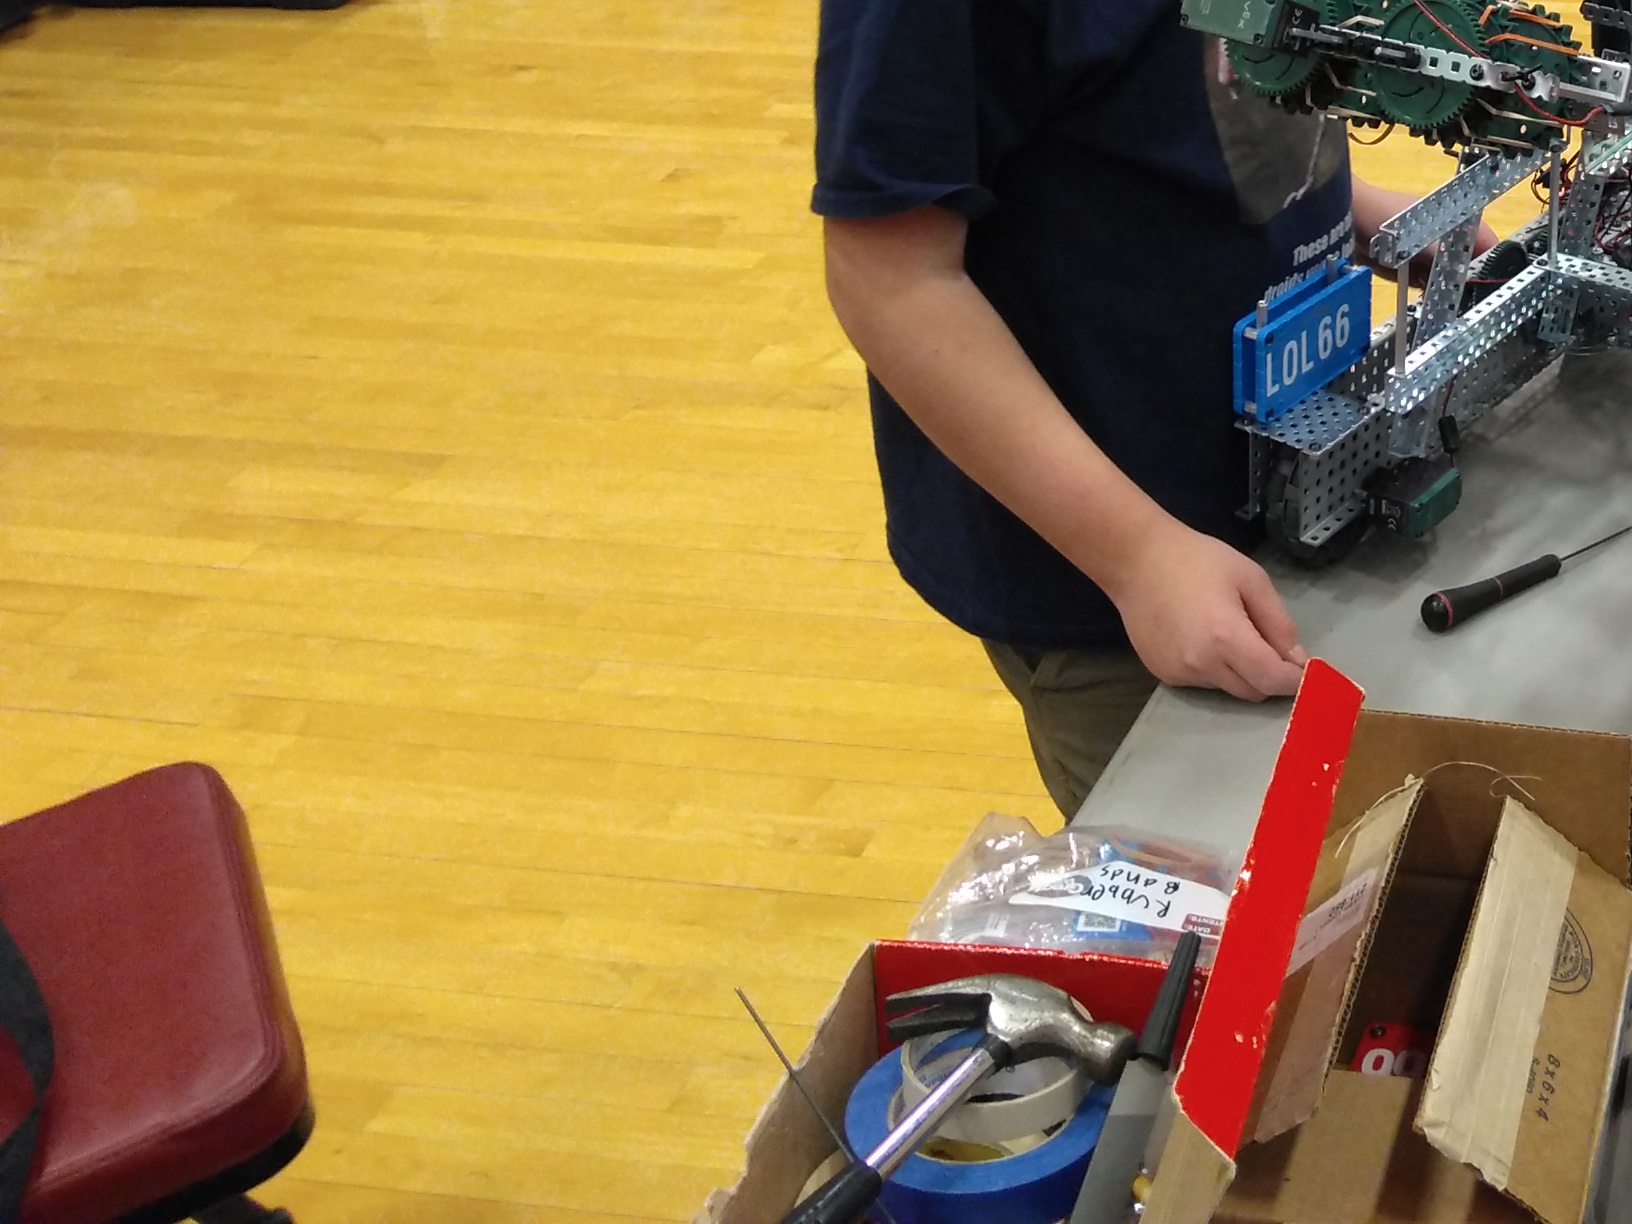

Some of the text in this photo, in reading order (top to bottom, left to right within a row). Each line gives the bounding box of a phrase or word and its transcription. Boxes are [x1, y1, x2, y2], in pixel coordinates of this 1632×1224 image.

[1292, 233, 1329, 267] These
[1266, 303, 1350, 398] LOL66
[1100, 864, 1181, 895] Bands
[1079, 883, 1172, 918] Rubber
